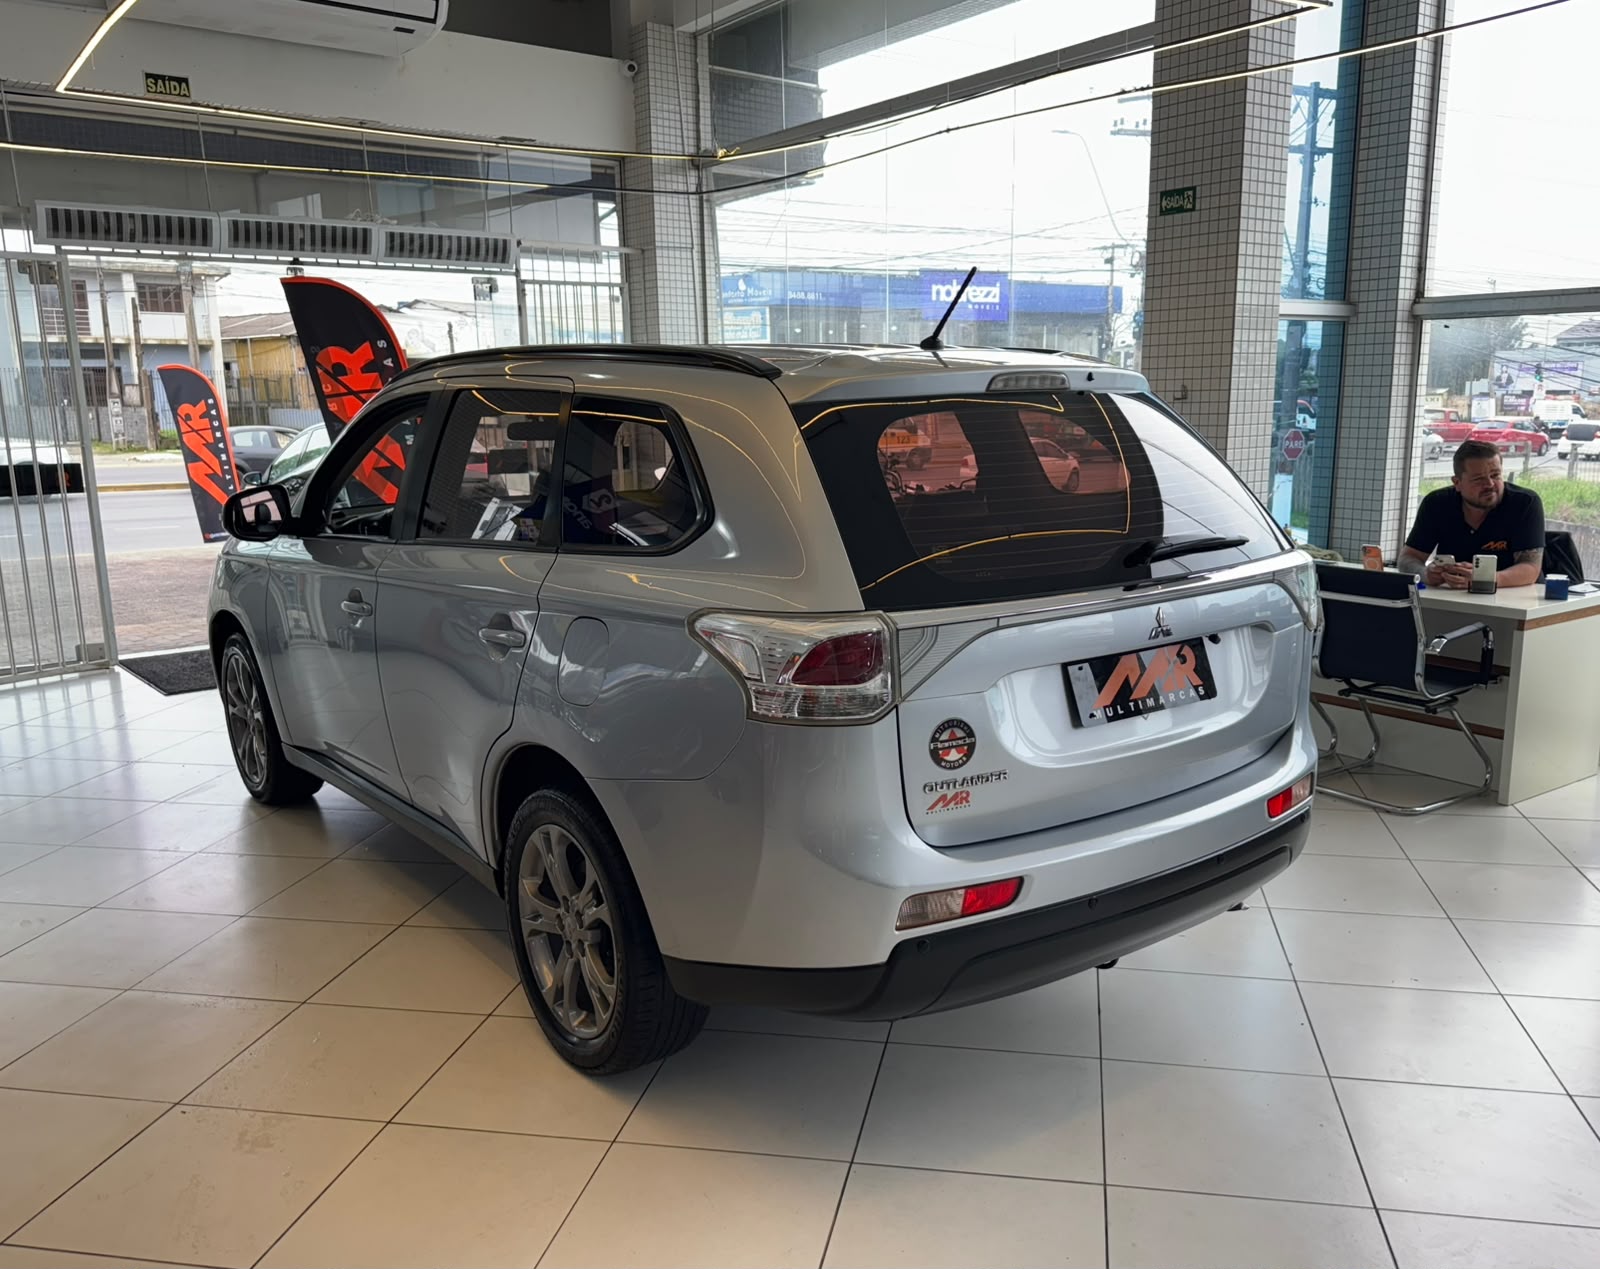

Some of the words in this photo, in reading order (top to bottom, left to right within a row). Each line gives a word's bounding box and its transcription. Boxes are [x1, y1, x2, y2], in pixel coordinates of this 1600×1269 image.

[147, 76, 190, 97] SAÍDA
[208, 398, 233, 490] LTIMARCAS
[1093, 686, 1205, 720] MULTIMARCAS
[941, 756, 967, 768] MOTORS
[923, 769, 1009, 795] OUTLANDER
